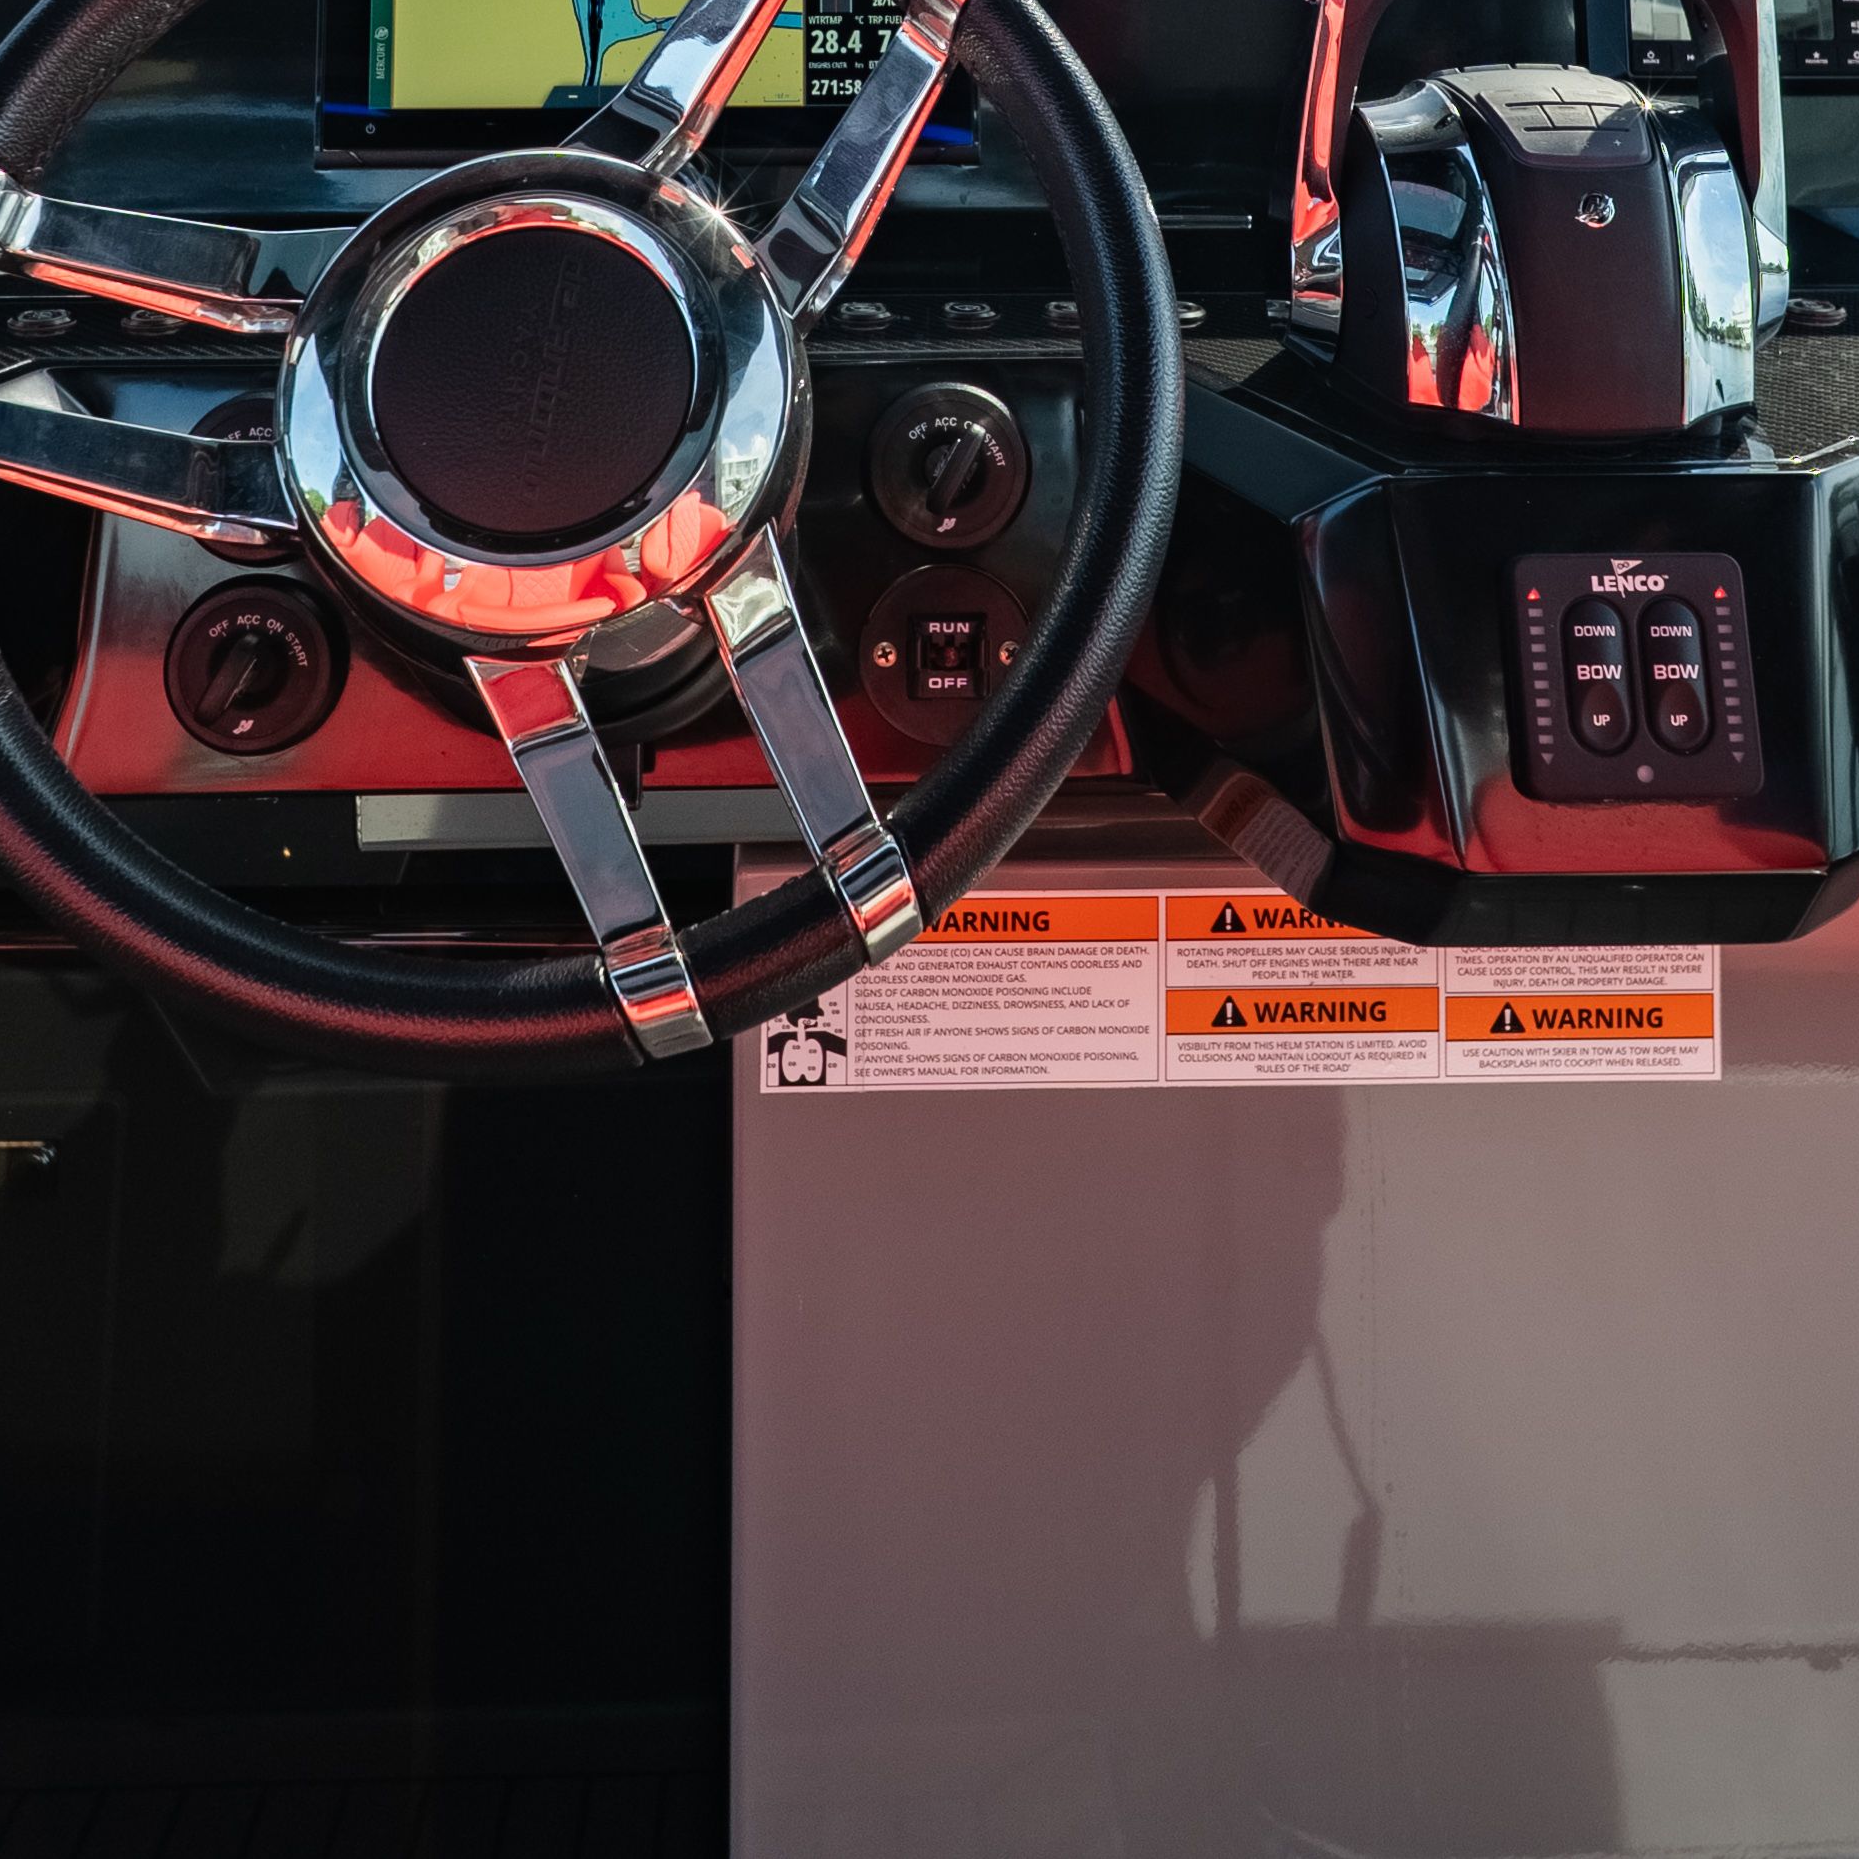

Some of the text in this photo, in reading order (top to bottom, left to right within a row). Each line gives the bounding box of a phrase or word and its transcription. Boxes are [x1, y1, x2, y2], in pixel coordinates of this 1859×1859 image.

[808, 16, 843, 24] WTRTMP
[868, 16, 883, 24] TRP
[810, 30, 862, 54] 28.4
[376, 42, 385, 79] MERCURY
[811, 79, 862, 95] 271:58
[934, 417, 957, 427] ACC
[908, 422, 928, 439] OFF
[984, 433, 1006, 466] START
[236, 615, 260, 625] ACC
[266, 619, 284, 633] ON
[208, 620, 229, 637] OFF
[929, 622, 969, 633] RUN
[1574, 625, 1616, 637] DOWN
[1650, 626, 1692, 637] DOWN
[285, 632, 308, 667] START
[1576, 664, 1622, 680] BOW
[1653, 664, 1699, 680] BOW
[928, 677, 967, 689] OFF
[1593, 714, 1610, 726] UP
[1670, 714, 1688, 726] UP
[896, 948, 948, 957] MONOXIDE
[950, 948, 971, 958] (CO)
[972, 948, 992, 957] CAN
[994, 948, 1024, 956] CAUSE
[1026, 947, 1055, 956] BRAIN
[1057, 947, 1098, 956] DAMAGE
[1099, 947, 1114, 956] OR
[894, 962, 916, 971] AND
[917, 961, 974, 970] GENERATOR
[975, 961, 1018, 970] EXHAUST
[1019, 961, 1068, 970] CONTAINS
[1069, 960, 1120, 969] ODORLESS
[1121, 960, 1142, 969] AND
[854, 975, 908, 984] COLORLESS
[909, 975, 950, 984] CARBON
[951, 974, 1004, 983] MONOXIDE
[854, 986, 1091, 997] SIGNS OF CARBON MONOXIDE POISONING INCLUDE
[1068, 1000, 1089, 1008] AND
[1091, 999, 1115, 1008] LACK
[1116, 999, 1130, 1008] OF
[1254, 1001, 1387, 1023] WARNING
[1532, 1007, 1663, 1029] WARNING
[854, 1025, 1149, 1037] GET FRESH AIR IF ANYONE SHOWS SIGNS OF CARBON MONOXIDE
[1176, 1042, 1222, 1051] VISIBILITY
[1223, 1041, 1251, 1050] FROM
[1252, 1041, 1274, 1050] THIS
[1275, 1041, 1303, 1050] HELM
[1304, 1040, 1344, 1049] STATION
[1346, 1040, 1355, 1049] IS
[1397, 1040, 1427, 1048] AVOID
[854, 1055, 864, 1063] IF
[863, 1054, 903, 1063] ANYONE
[905, 1054, 941, 1063] SHOWS
[942, 1054, 971, 1062] SIGNS
[972, 1054, 986, 1062] OF
[987, 1053, 1027, 1062] CARBON
[1029, 1053, 1081, 1062] MONOXIDE
[1177, 1051, 1426, 1062] COLLISIONS AND MAINTAIN LOOKOUT AS REQUIRED IN
[854, 1068, 870, 1077] SEE
[917, 1067, 958, 1076] MANUAL
[959, 1067, 979, 1076] FOR
[1286, 1064, 1300, 1073] OF
[1301, 1064, 1320, 1073] THE
